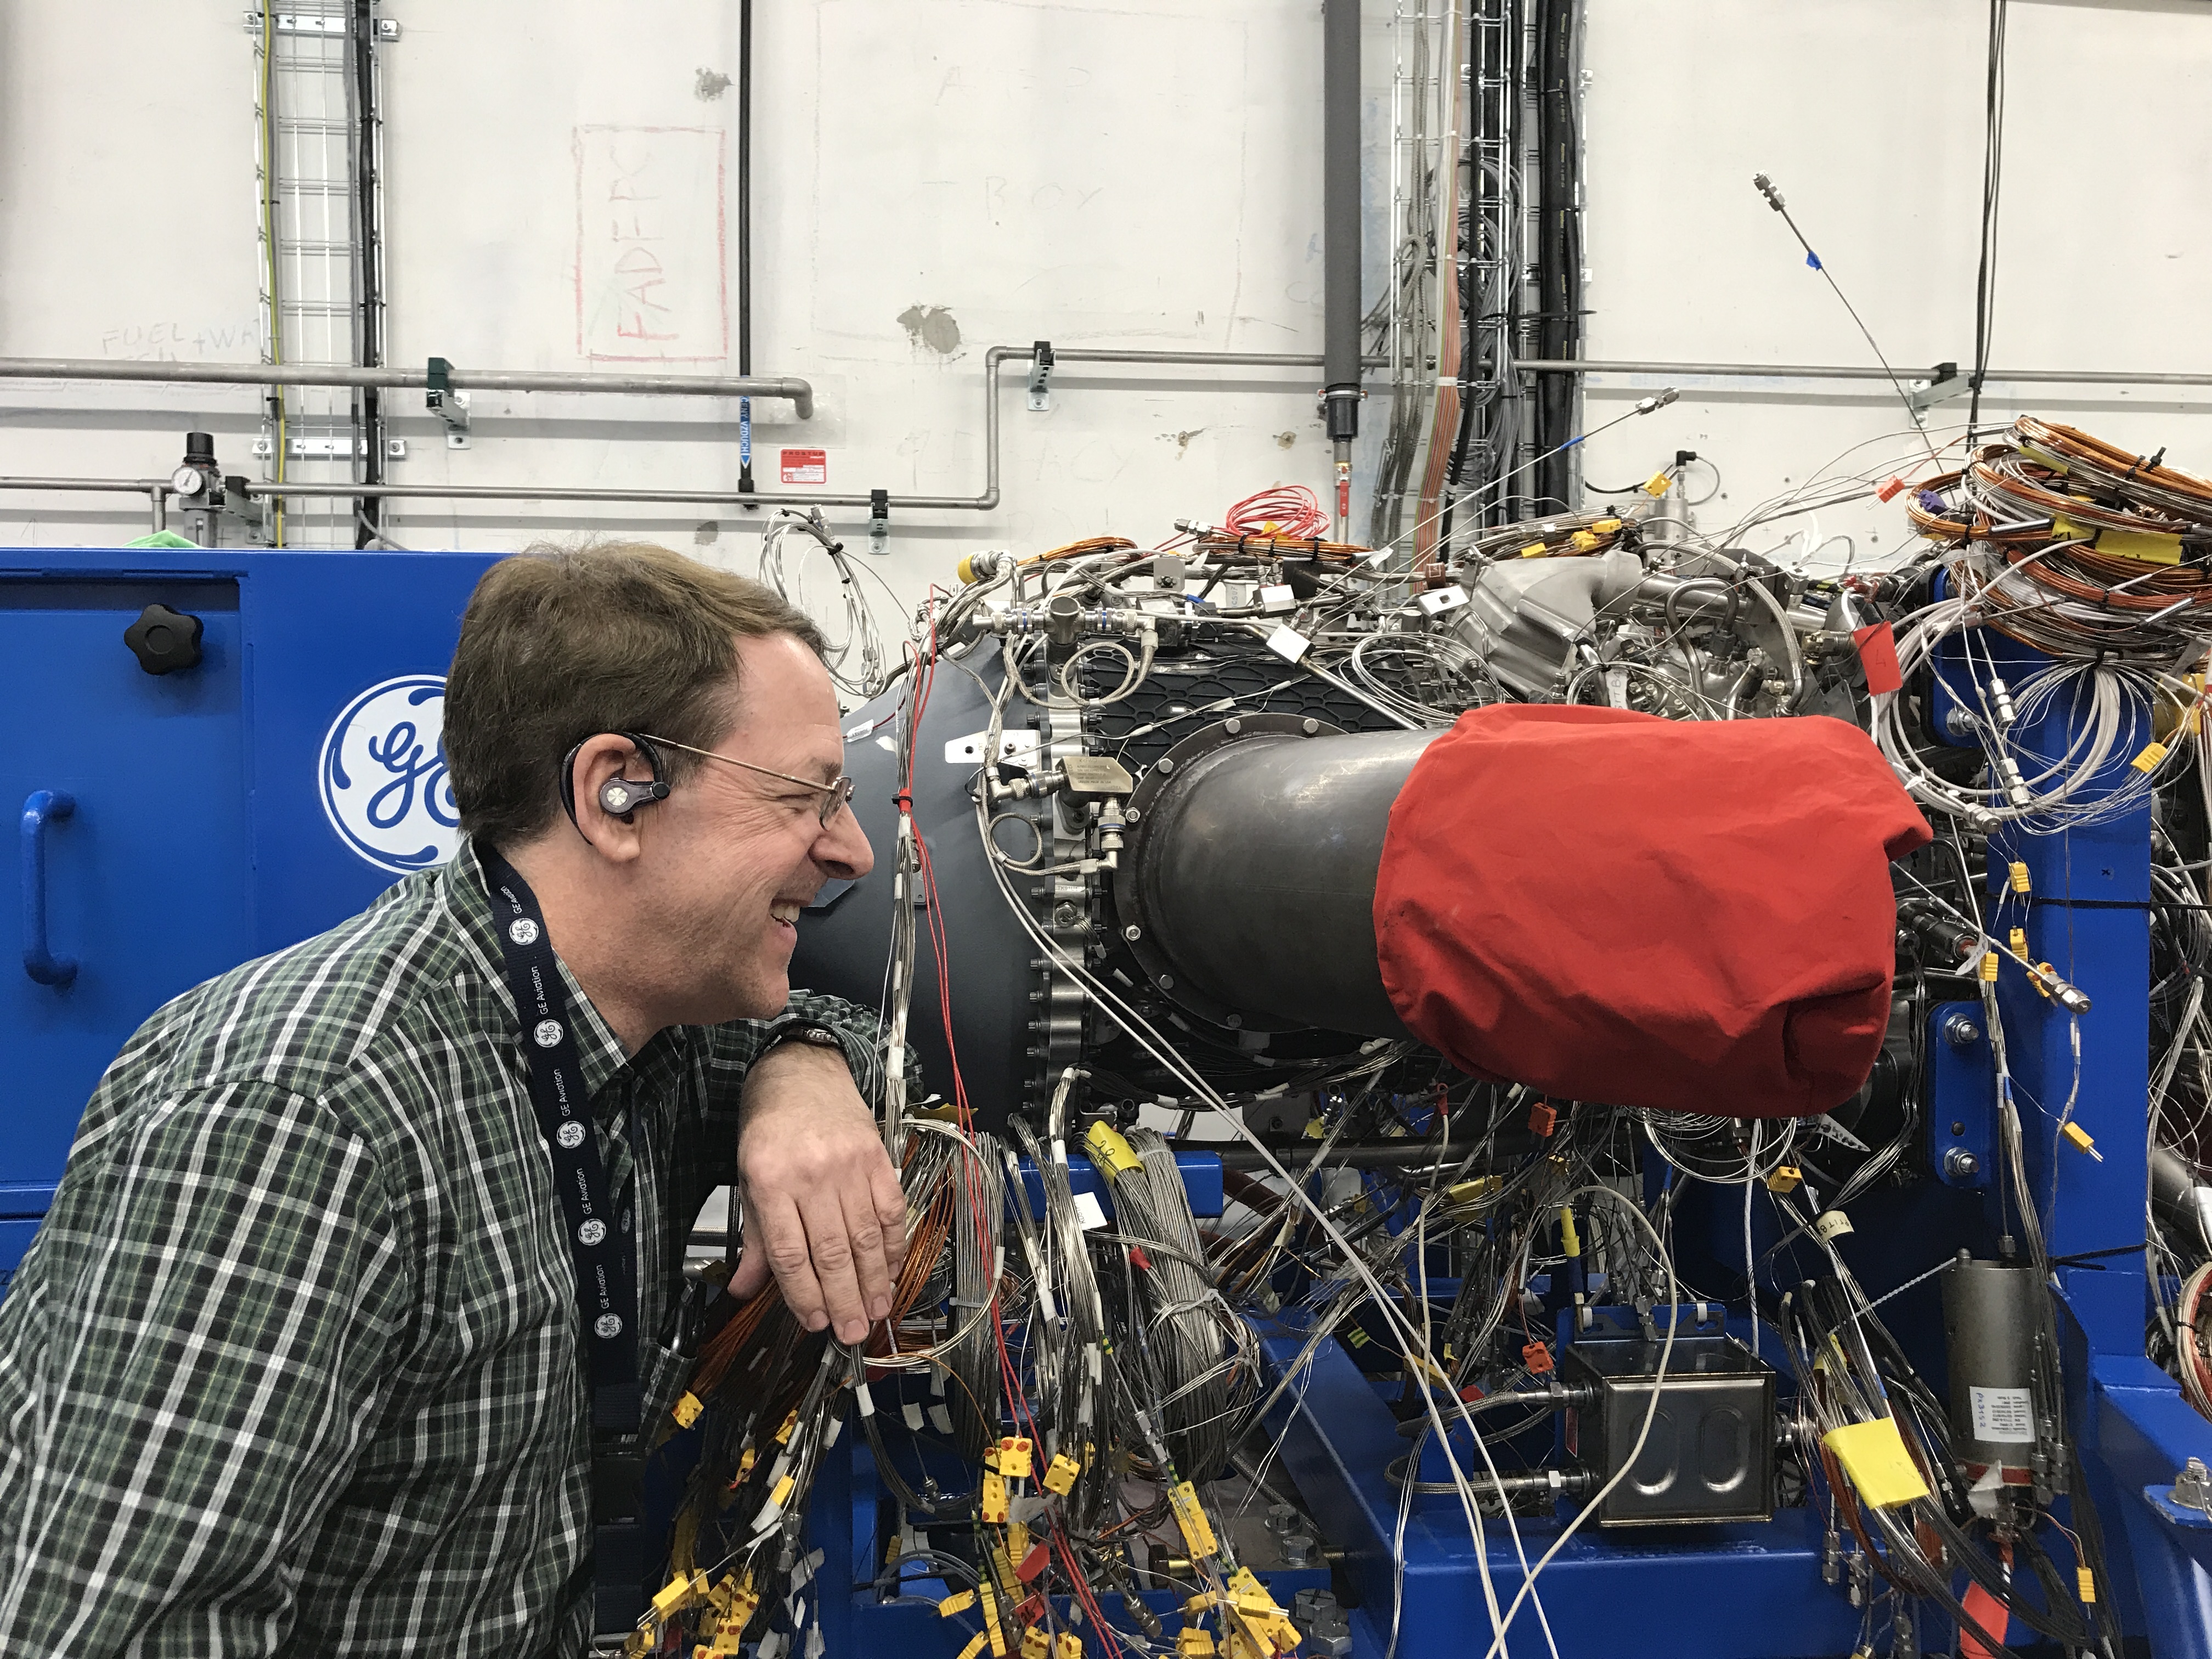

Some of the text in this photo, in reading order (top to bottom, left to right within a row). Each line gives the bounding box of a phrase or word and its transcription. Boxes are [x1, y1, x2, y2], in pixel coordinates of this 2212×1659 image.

[531, 966, 549, 1015] GE Aviation
[554, 1068, 571, 1117] GE Aviation
[577, 1167, 592, 1215] GE Aviation
[596, 1264, 610, 1309] GE Aviation
